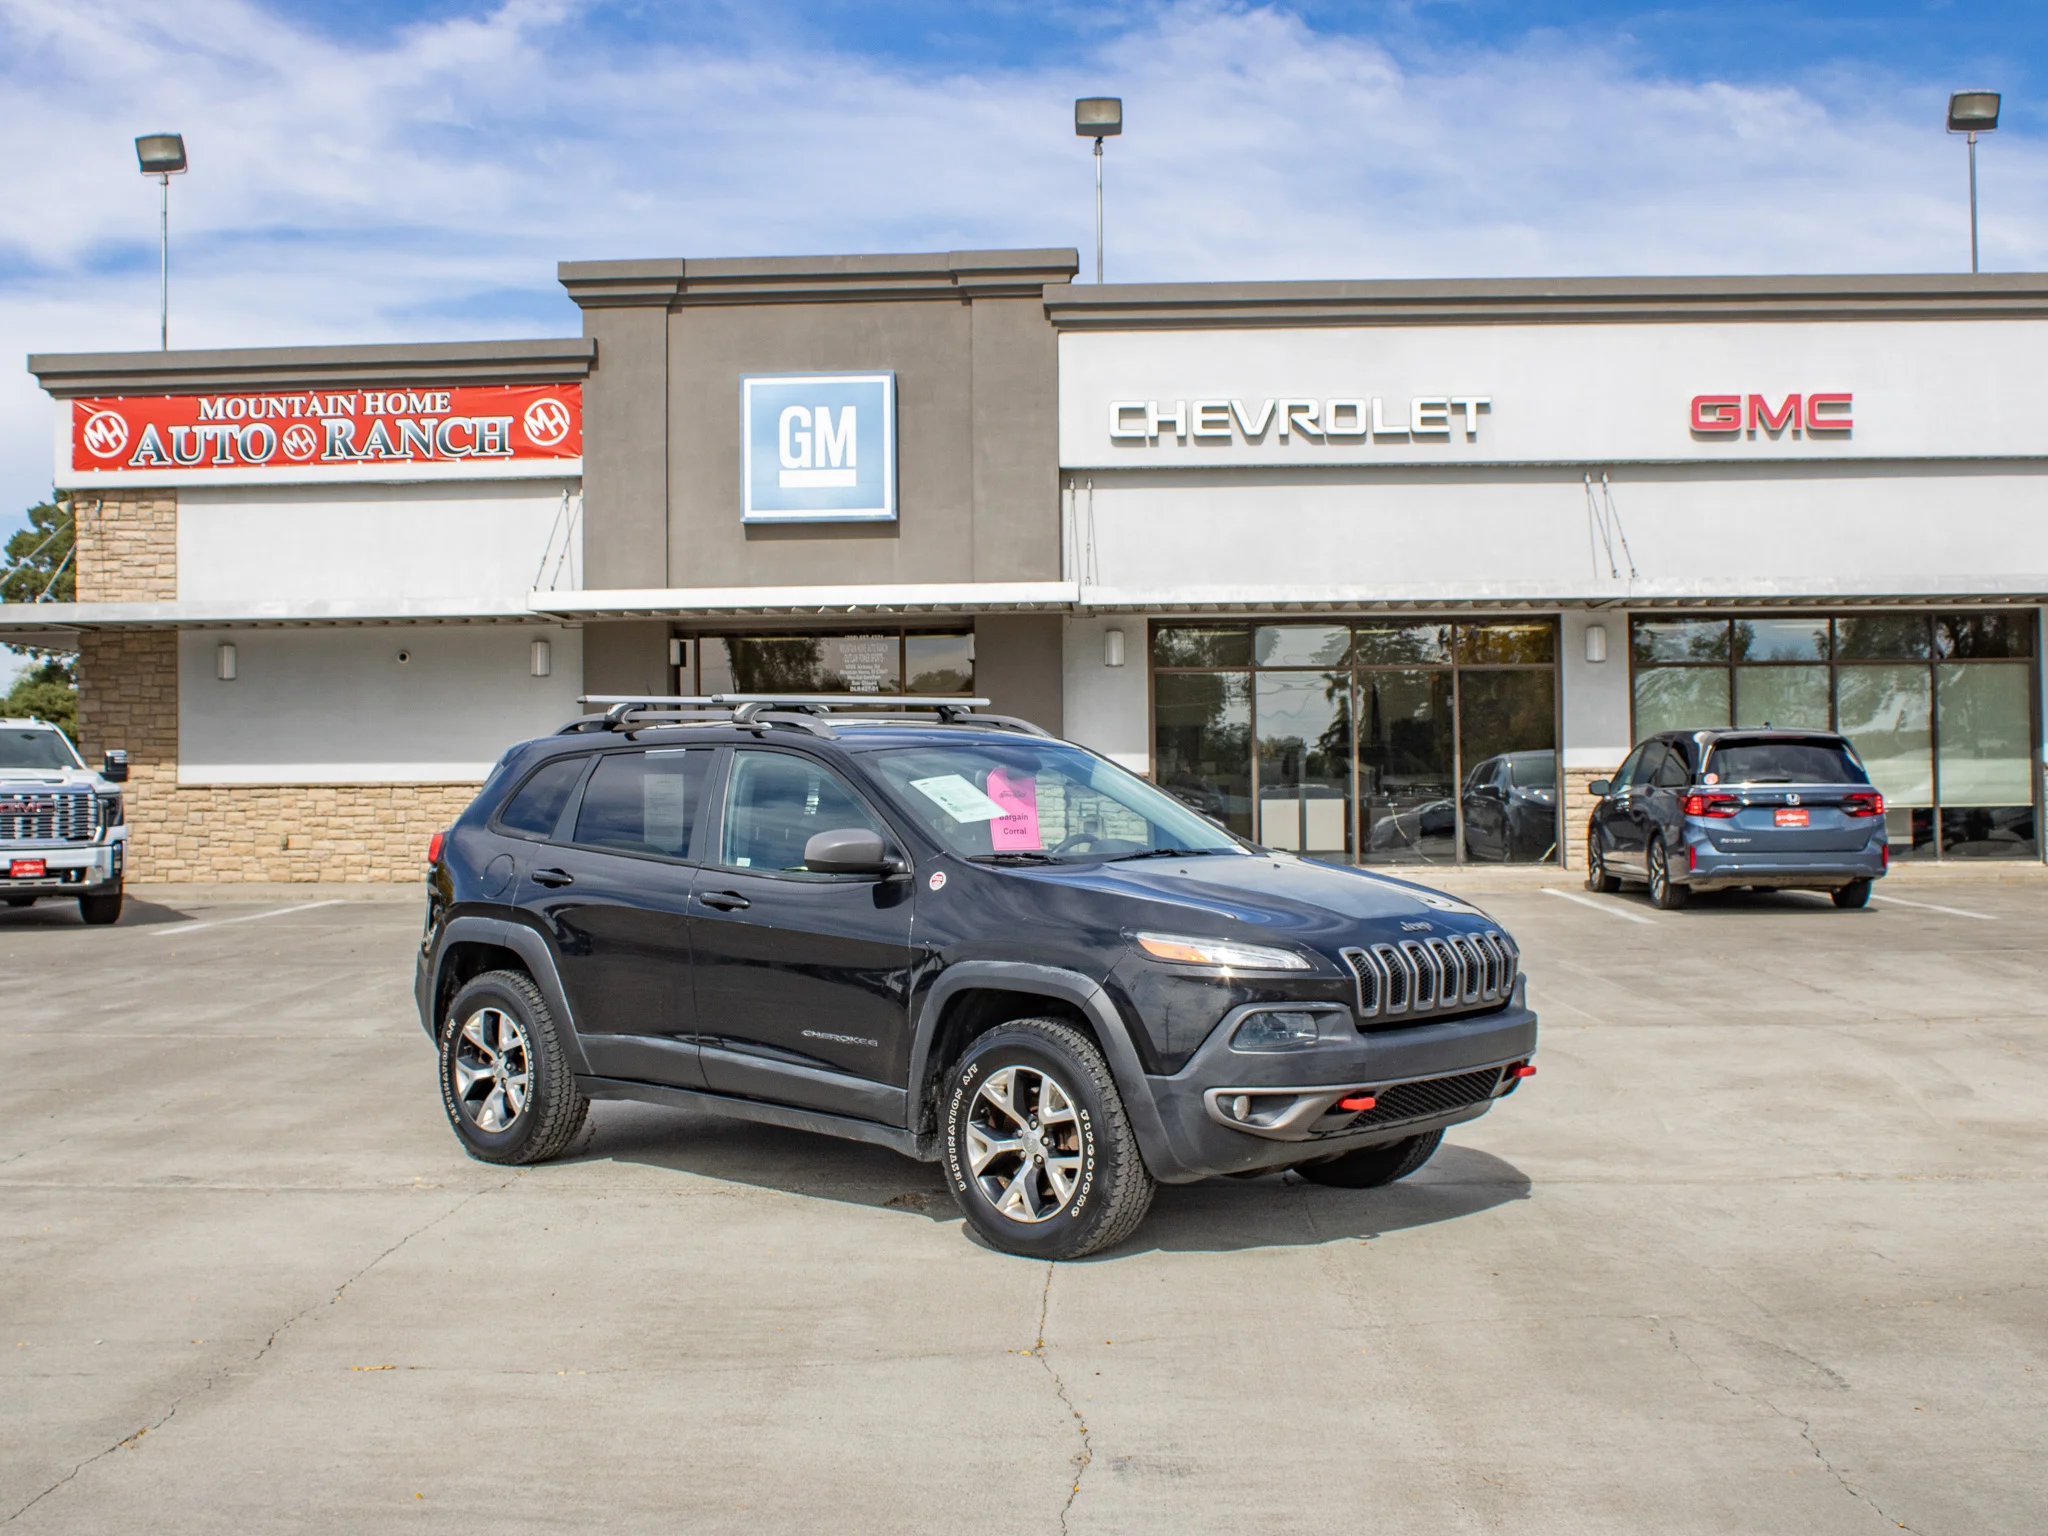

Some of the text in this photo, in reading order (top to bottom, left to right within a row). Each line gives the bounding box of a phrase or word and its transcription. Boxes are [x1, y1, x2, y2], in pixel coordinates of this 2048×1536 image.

[197, 391, 451, 420] MOUNTAIN HOME
[525, 399, 570, 443] MH
[1108, 395, 1492, 438] CHEVROLET
[1691, 393, 1853, 432] GMC
[85, 413, 128, 456] MH
[128, 422, 277, 466] AUTO
[320, 416, 514, 461] RANCH
[779, 405, 857, 469] GM
[1400, 921, 1433, 932] Jeep
[947, 1063, 979, 1192] DESTINATION A/T
